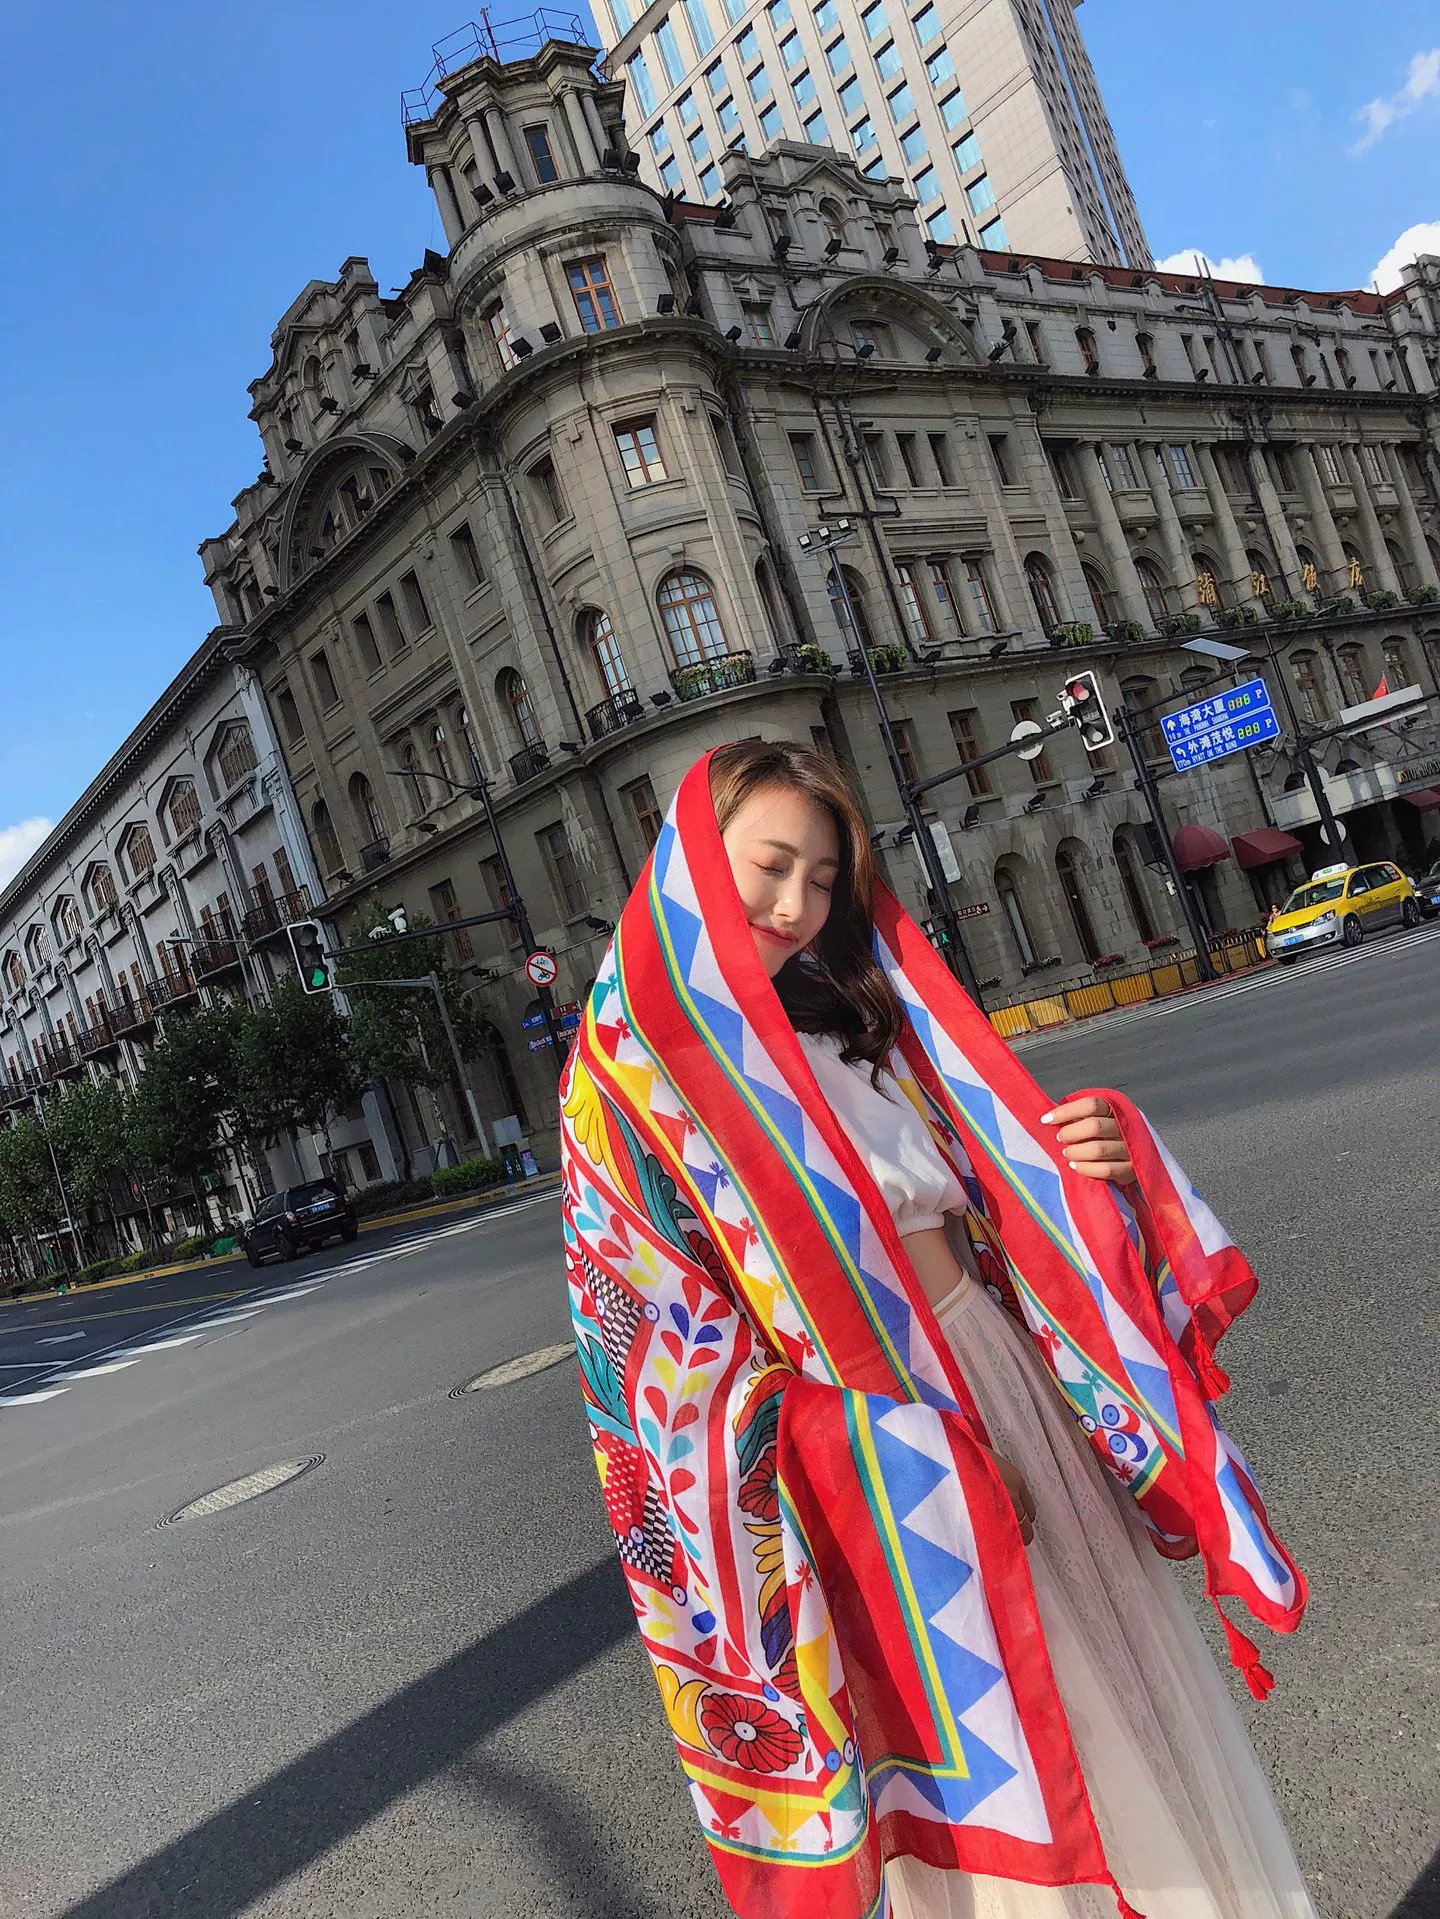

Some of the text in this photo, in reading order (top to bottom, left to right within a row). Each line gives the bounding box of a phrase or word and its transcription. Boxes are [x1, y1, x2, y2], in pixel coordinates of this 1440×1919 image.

[1179, 699, 1226, 728] 海湾大厦
[1255, 688, 1262, 699] P
[1188, 726, 1235, 755] 外滩茂悦
[1264, 718, 1272, 729] P
[1191, 752, 1206, 763] HYATT
[1214, 746, 1224, 755] THE
